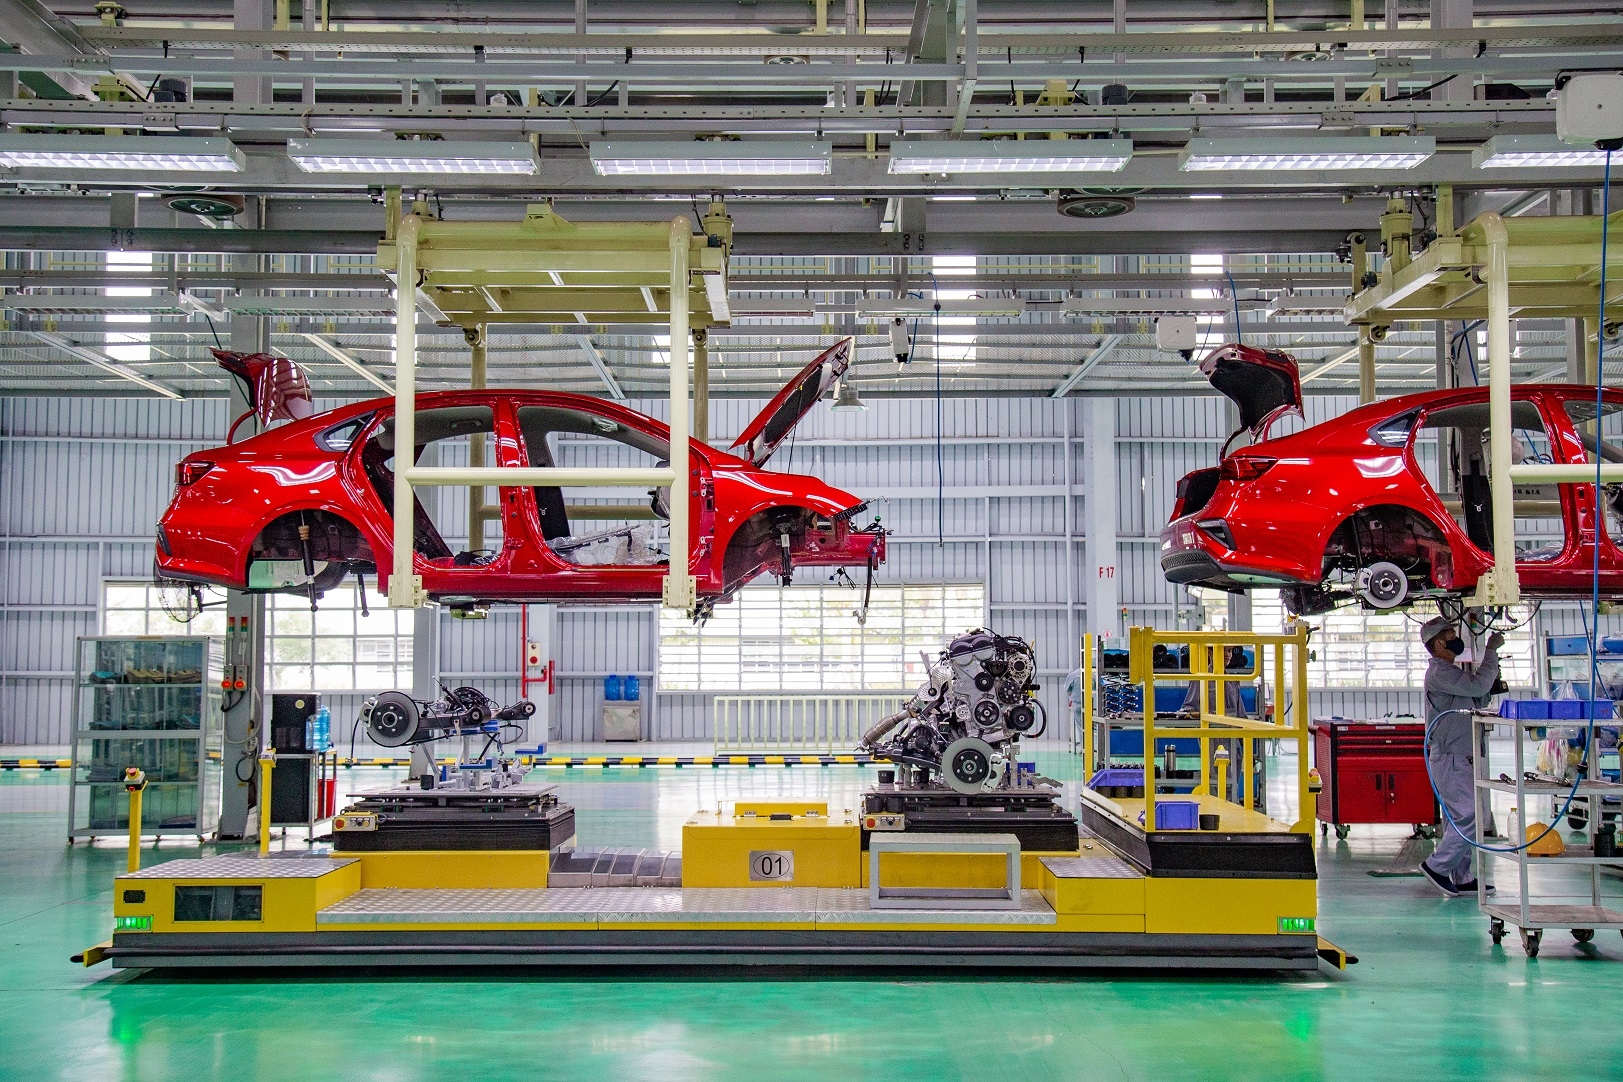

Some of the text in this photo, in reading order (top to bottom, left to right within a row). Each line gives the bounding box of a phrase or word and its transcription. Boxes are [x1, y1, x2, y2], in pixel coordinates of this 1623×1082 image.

[1099, 566, 1114, 579] F 17
[761, 856, 782, 875] 01
